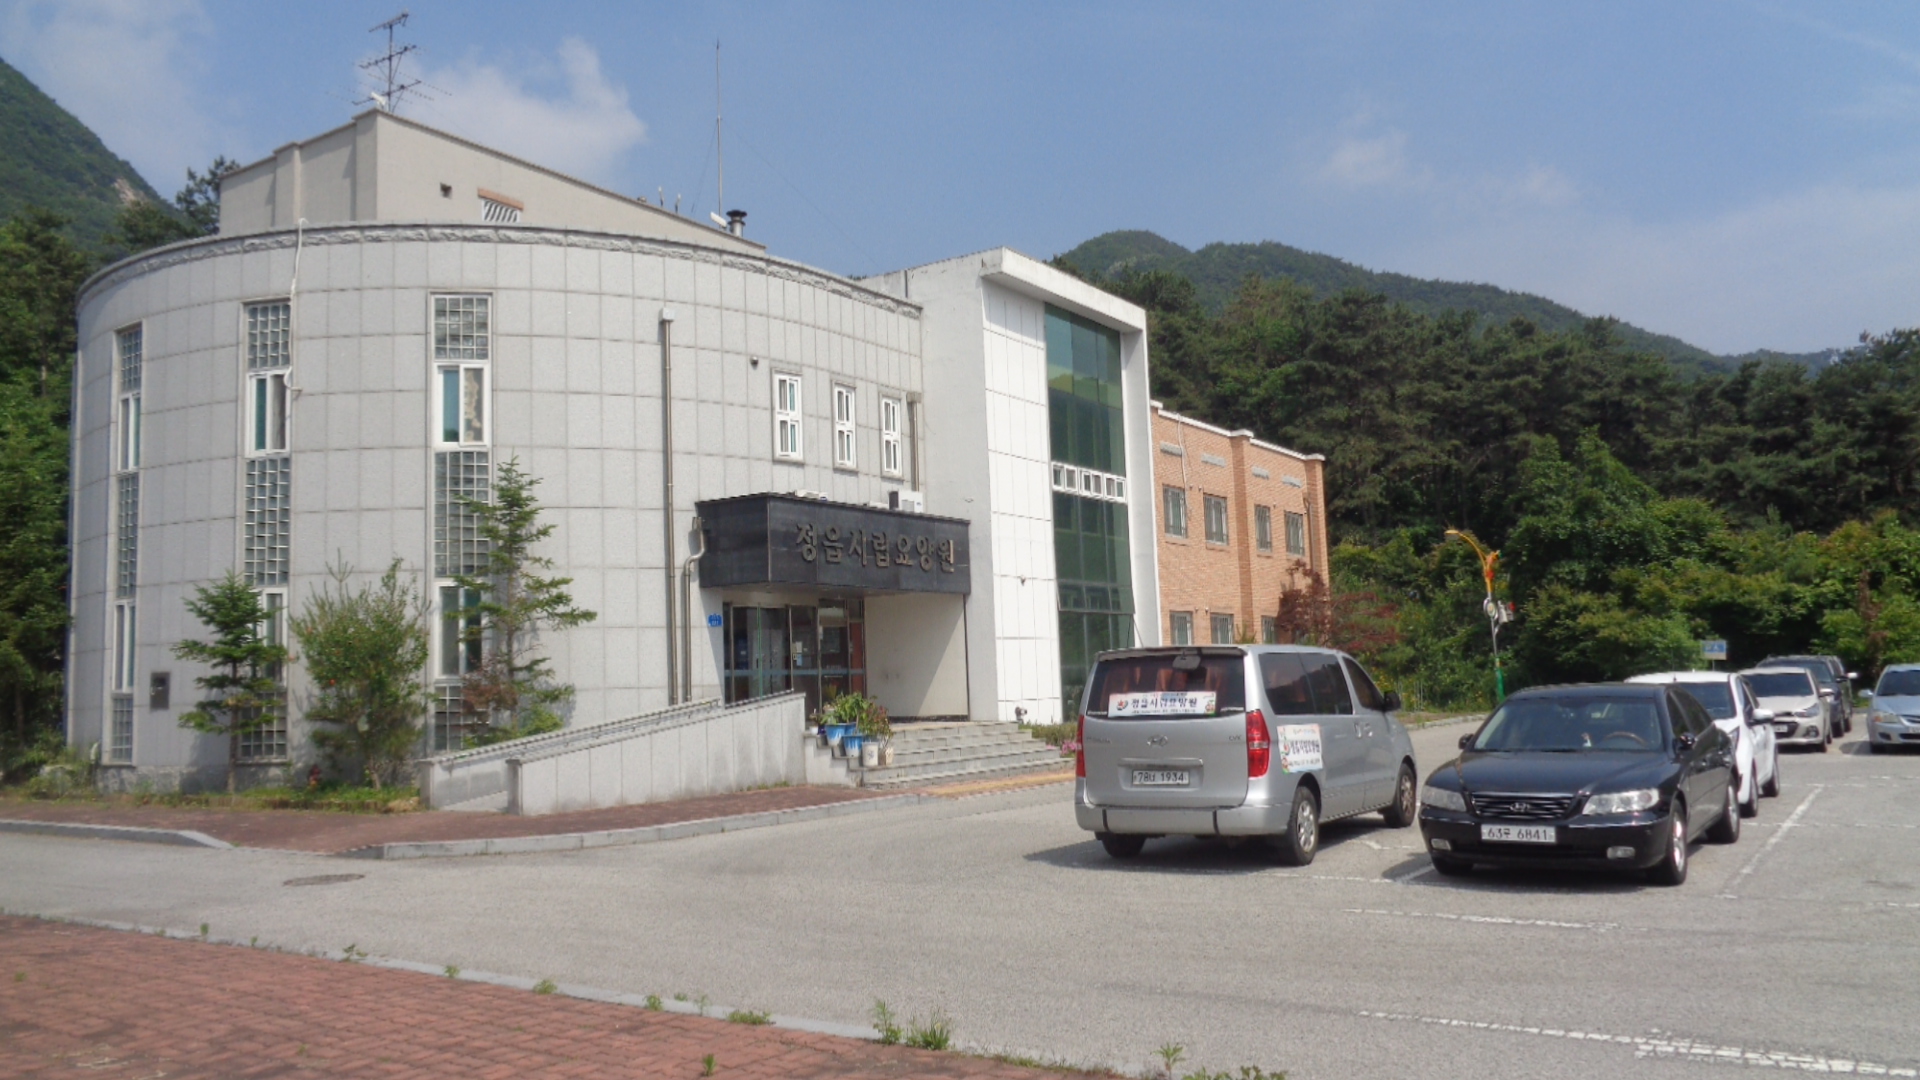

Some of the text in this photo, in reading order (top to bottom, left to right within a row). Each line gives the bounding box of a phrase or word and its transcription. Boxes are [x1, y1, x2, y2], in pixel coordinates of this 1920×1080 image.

[796, 523, 956, 573] 정읍시립요양원
[1160, 771, 1184, 782] 1934
[1517, 828, 1547, 840] 6841
